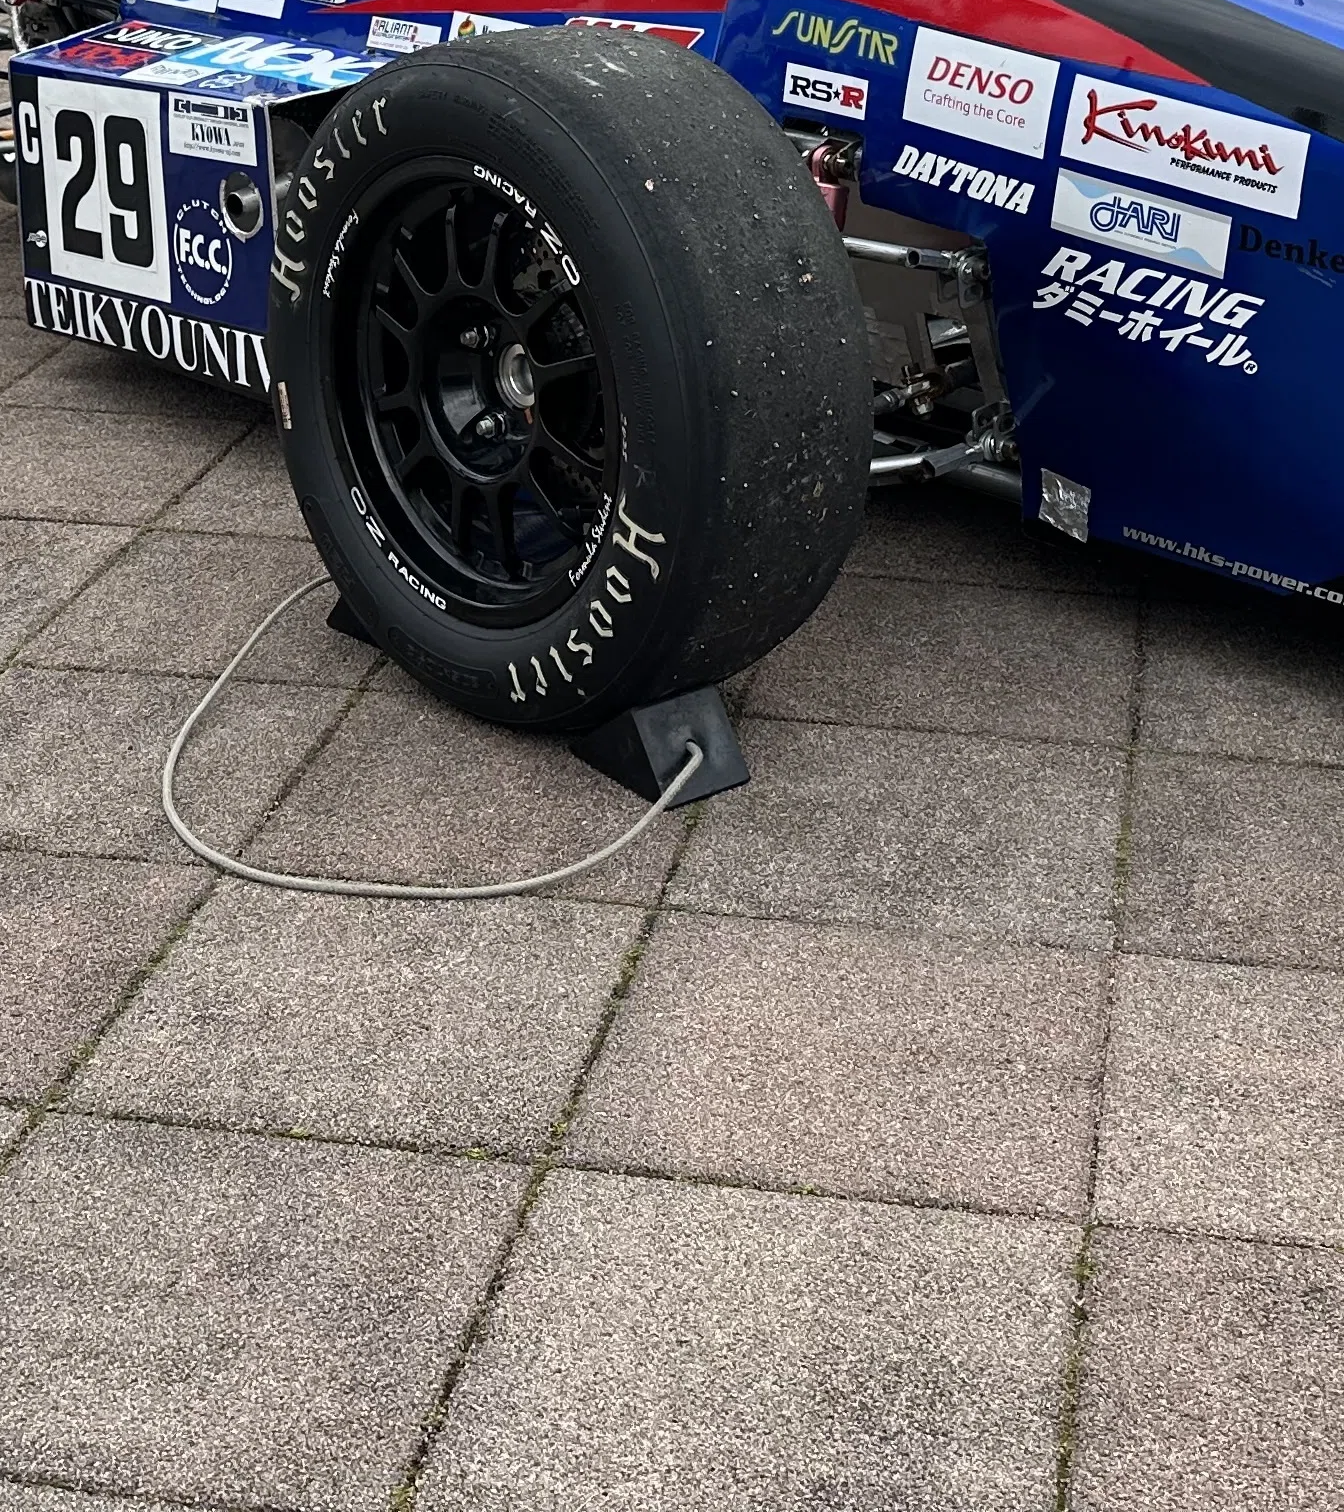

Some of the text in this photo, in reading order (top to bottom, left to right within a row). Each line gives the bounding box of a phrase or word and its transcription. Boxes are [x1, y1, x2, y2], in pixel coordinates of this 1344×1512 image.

[772, 11, 899, 66] SUNSTAR
[927, 56, 1034, 105] DENSO
[191, 122, 231, 147] KYOWA
[923, 89, 1026, 129] Crafting the Core
[19, 101, 154, 268] C 29
[270, 96, 387, 303] Hoosier
[473, 164, 538, 219] RACING
[893, 145, 1035, 216] DAYTONA
[1170, 157, 1278, 194] PERFORMANCE PRODUCTS
[176, 199, 227, 234] CLUTCH
[177, 264, 229, 305] TECHNOLOGY
[1040, 246, 1265, 331] RACING
[568, 491, 613, 587] Formula Student
[387, 551, 448, 610] RACING
[508, 489, 667, 703] Hoosier
